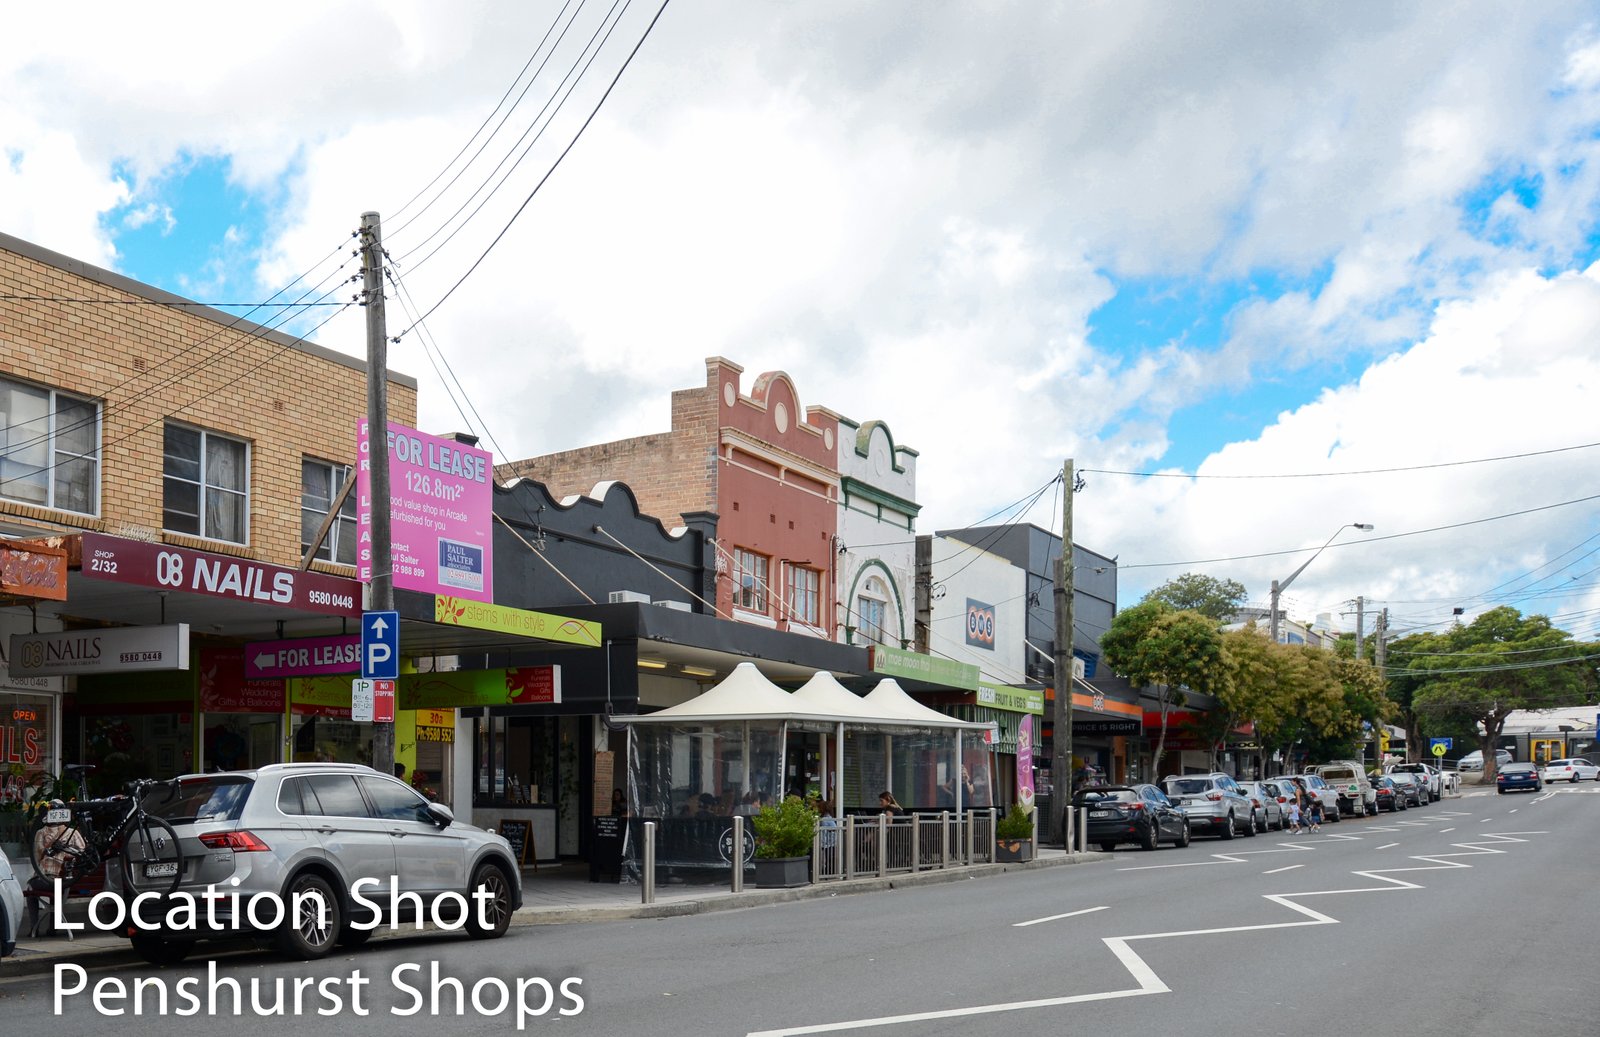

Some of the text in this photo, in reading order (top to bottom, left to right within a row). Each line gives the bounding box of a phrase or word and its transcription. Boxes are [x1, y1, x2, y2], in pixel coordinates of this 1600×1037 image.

[386, 431, 486, 484] FOR LEASE
[390, 496, 468, 522] ood value shop in Arcade
[390, 510, 446, 531] efurbished for you
[94, 549, 115, 559] SHOP
[390, 542, 410, 552] ontact
[447, 544, 466, 556] PAUL
[91, 558, 118, 574] 2/32
[399, 554, 420, 565] Salter
[447, 552, 474, 567] SALTER
[156, 551, 353, 609] 08 NAILS 9580 0448
[467, 604, 545, 633] stems with style
[21, 640, 44, 669] 08
[46, 637, 102, 661] NAILS
[119, 651, 163, 663] 9580 0448
[278, 643, 361, 668] FOR LEASE
[368, 643, 392, 674] P
[240, 687, 282, 699] Weddings
[995, 692, 1008, 706] FRUIT
[1009, 694, 1013, 706] &
[218, 697, 237, 706] Gifts
[239, 697, 245, 706] &
[13, 710, 36, 721] OPEN
[430, 712, 443, 725] 30a
[1072, 723, 1097, 731] PRICE
[1109, 722, 1136, 731] RIGHT
